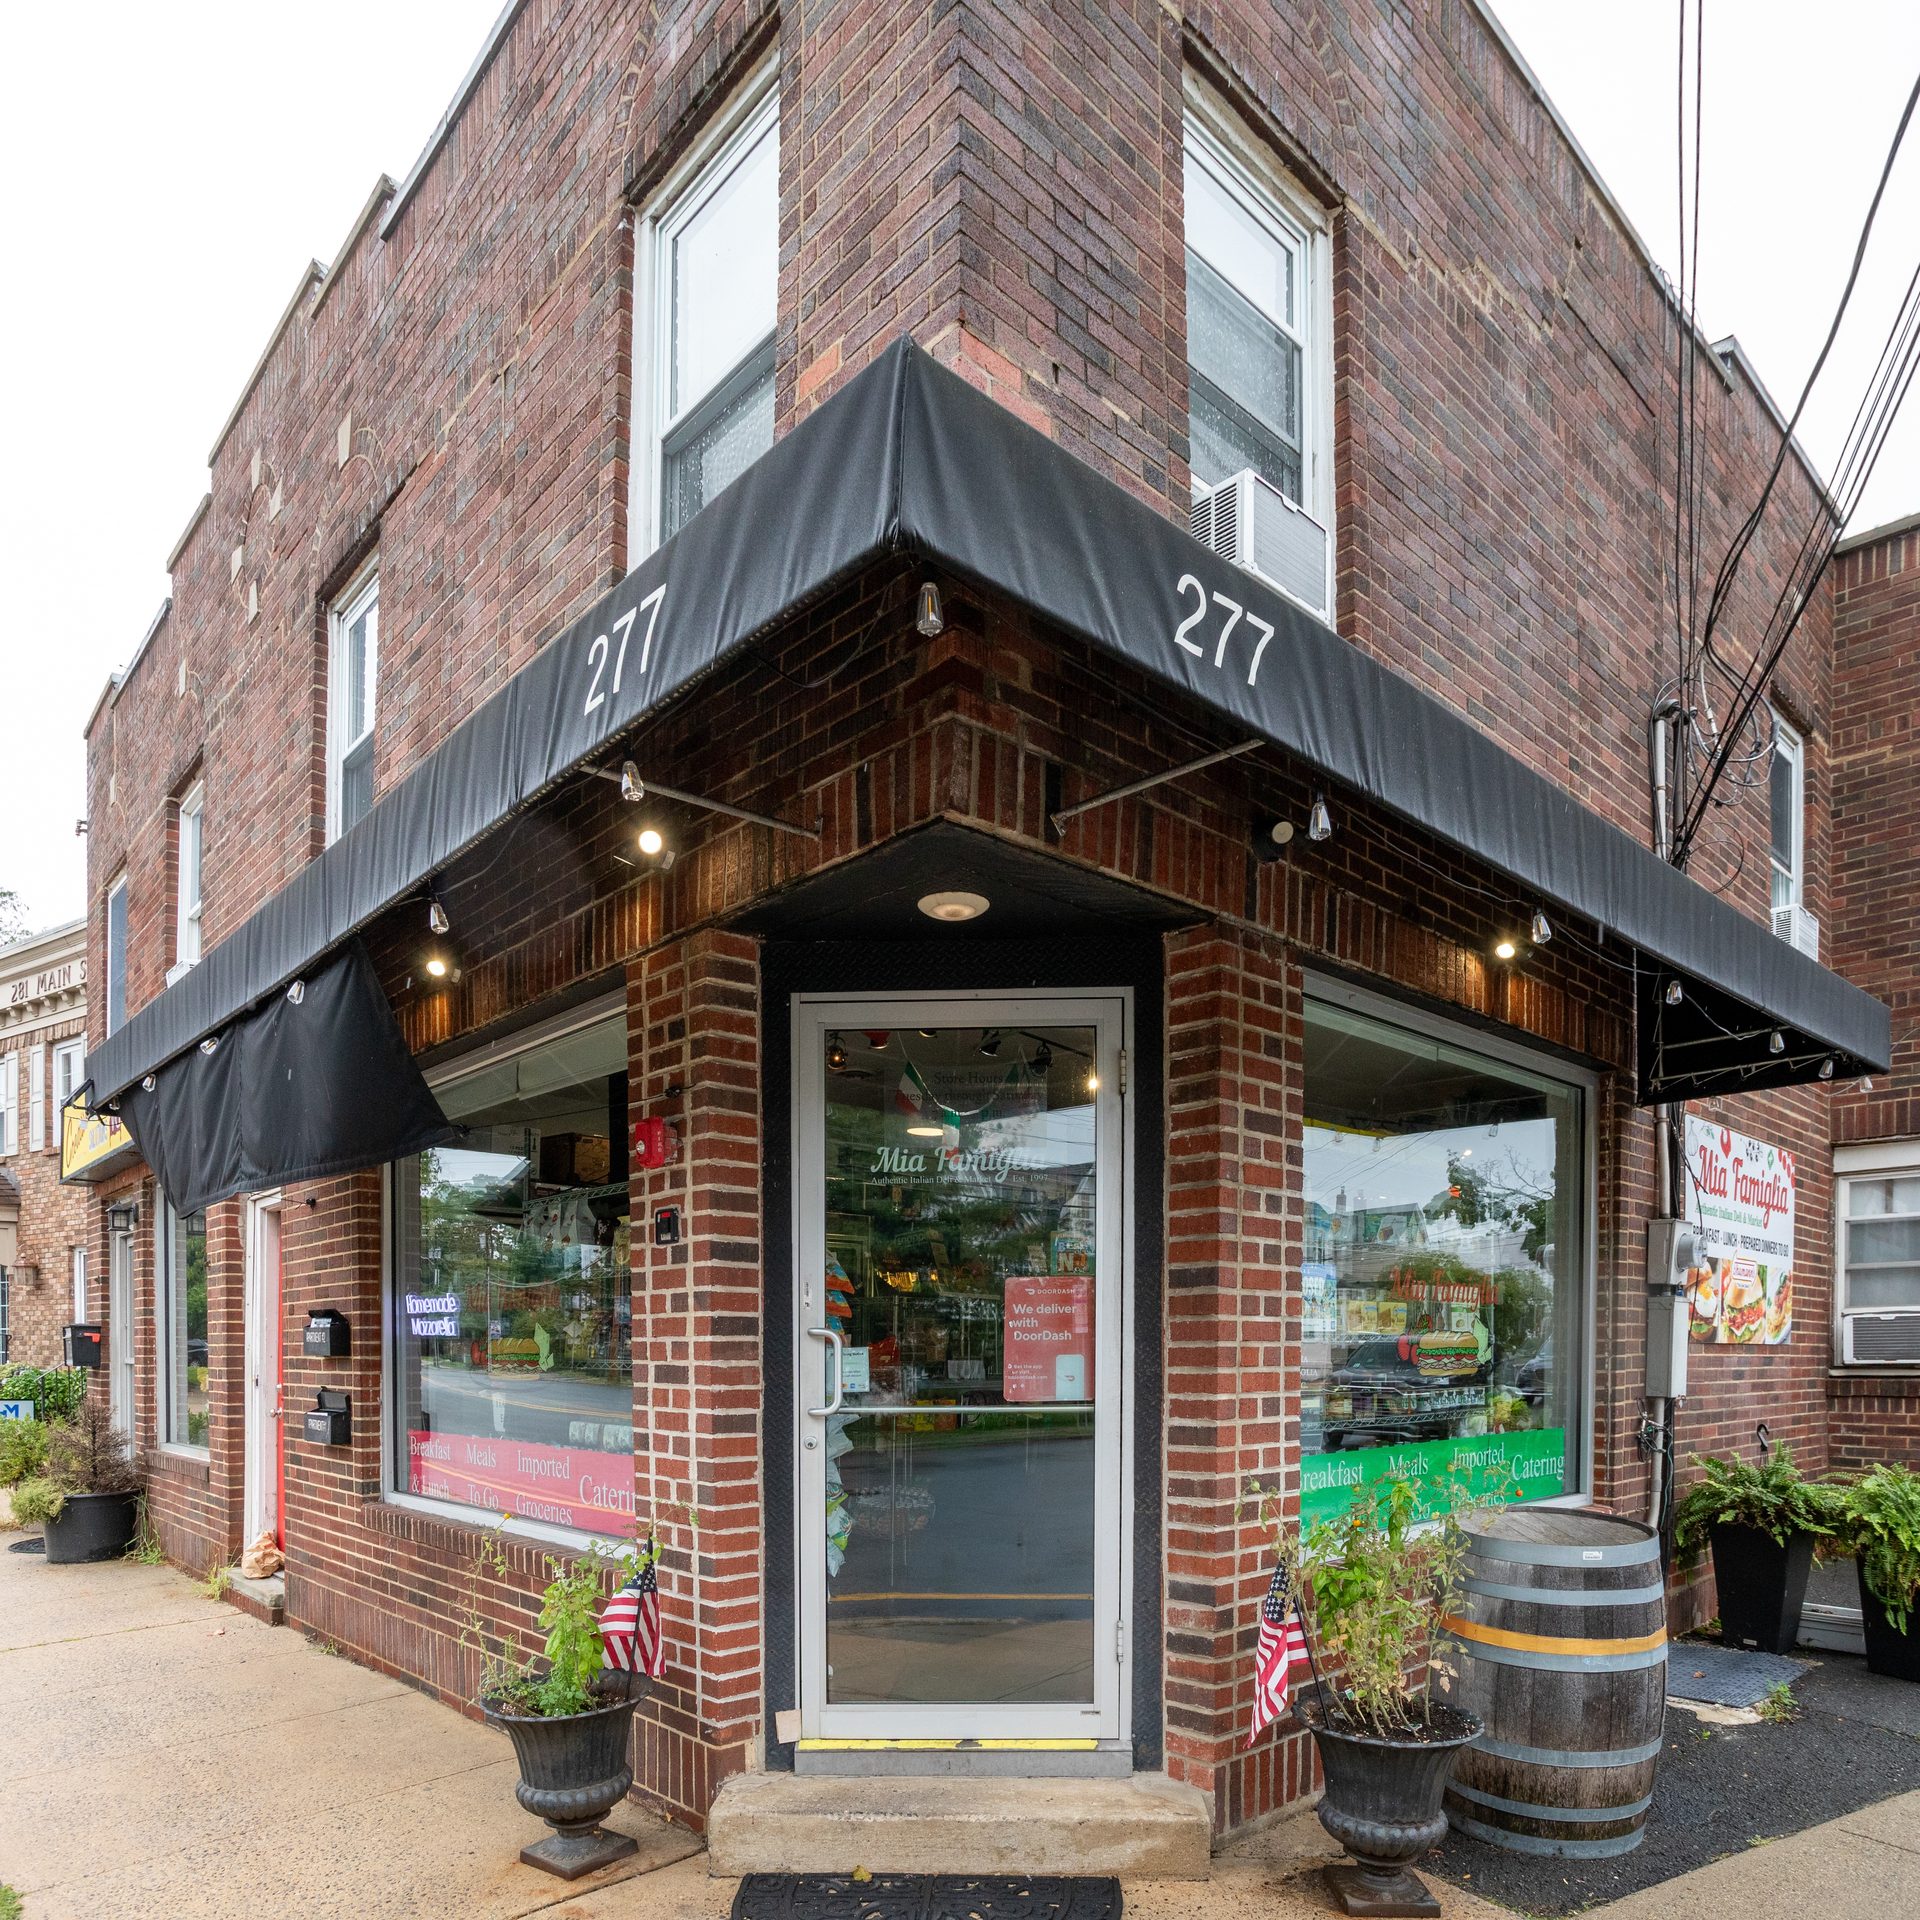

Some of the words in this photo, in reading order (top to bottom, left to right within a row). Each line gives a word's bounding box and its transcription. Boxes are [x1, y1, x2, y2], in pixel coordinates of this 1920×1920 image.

[1174, 573, 1275, 687] 277
[584, 583, 666, 716] 277
[11, 980, 29, 1003] 281
[36, 965, 72, 995] MAIN
[870, 1146, 927, 1173] Mia
[871, 1175, 908, 1185] Authentic
[910, 1175, 934, 1184] Italian
[1695, 1144, 1729, 1199] Mia
[1732, 1156, 1789, 1230] Famiglia
[1722, 1230, 1738, 1248] LUNCH
[1740, 1234, 1761, 1252] PREPARED
[405, 1292, 458, 1314] Homemade
[1388, 1266, 1426, 1301] Mia
[1430, 1267, 1499, 1313] Famiglia
[1011, 1317, 1039, 1329] with
[1012, 1303, 1034, 1315] We
[1036, 1303, 1078, 1315] deliver
[1013, 1330, 1072, 1342] DoorDash
[409, 1435, 451, 1461] Breakfast
[465, 1443, 497, 1468] Meals
[517, 1450, 570, 1480] Imported
[1453, 1442, 1505, 1470] Imported
[1511, 1450, 1565, 1481] Catering
[411, 1473, 420, 1493] &
[421, 1474, 450, 1499] Lunch
[467, 1483, 480, 1505] To
[483, 1486, 499, 1510] Go
[1300, 1460, 1364, 1492] reakfast
[516, 1491, 573, 1526] Groceries
